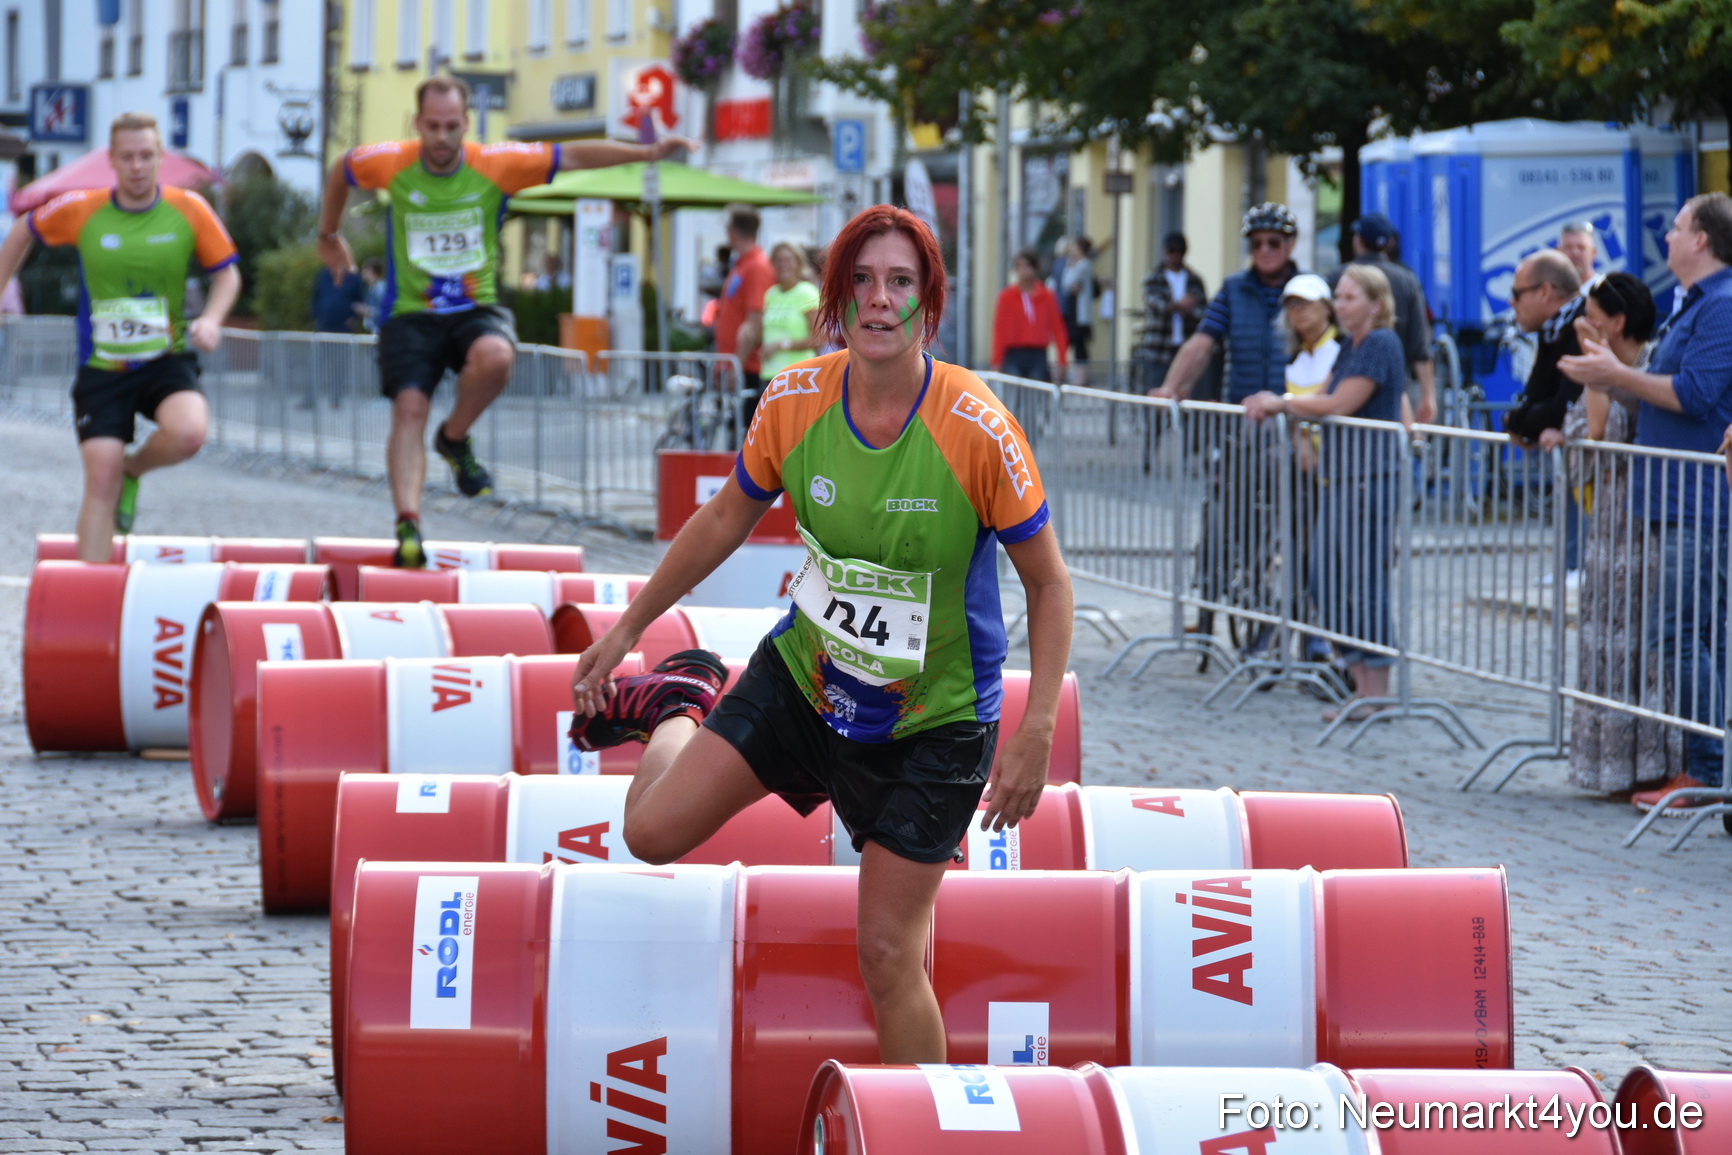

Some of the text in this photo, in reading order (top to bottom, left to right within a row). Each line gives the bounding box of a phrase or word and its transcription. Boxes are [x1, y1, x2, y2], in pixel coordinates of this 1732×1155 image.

[425, 233, 467, 252] 129
[951, 391, 1033, 500] BOCK
[886, 498, 938, 512] BOCK
[911, 614, 923, 623] E6
